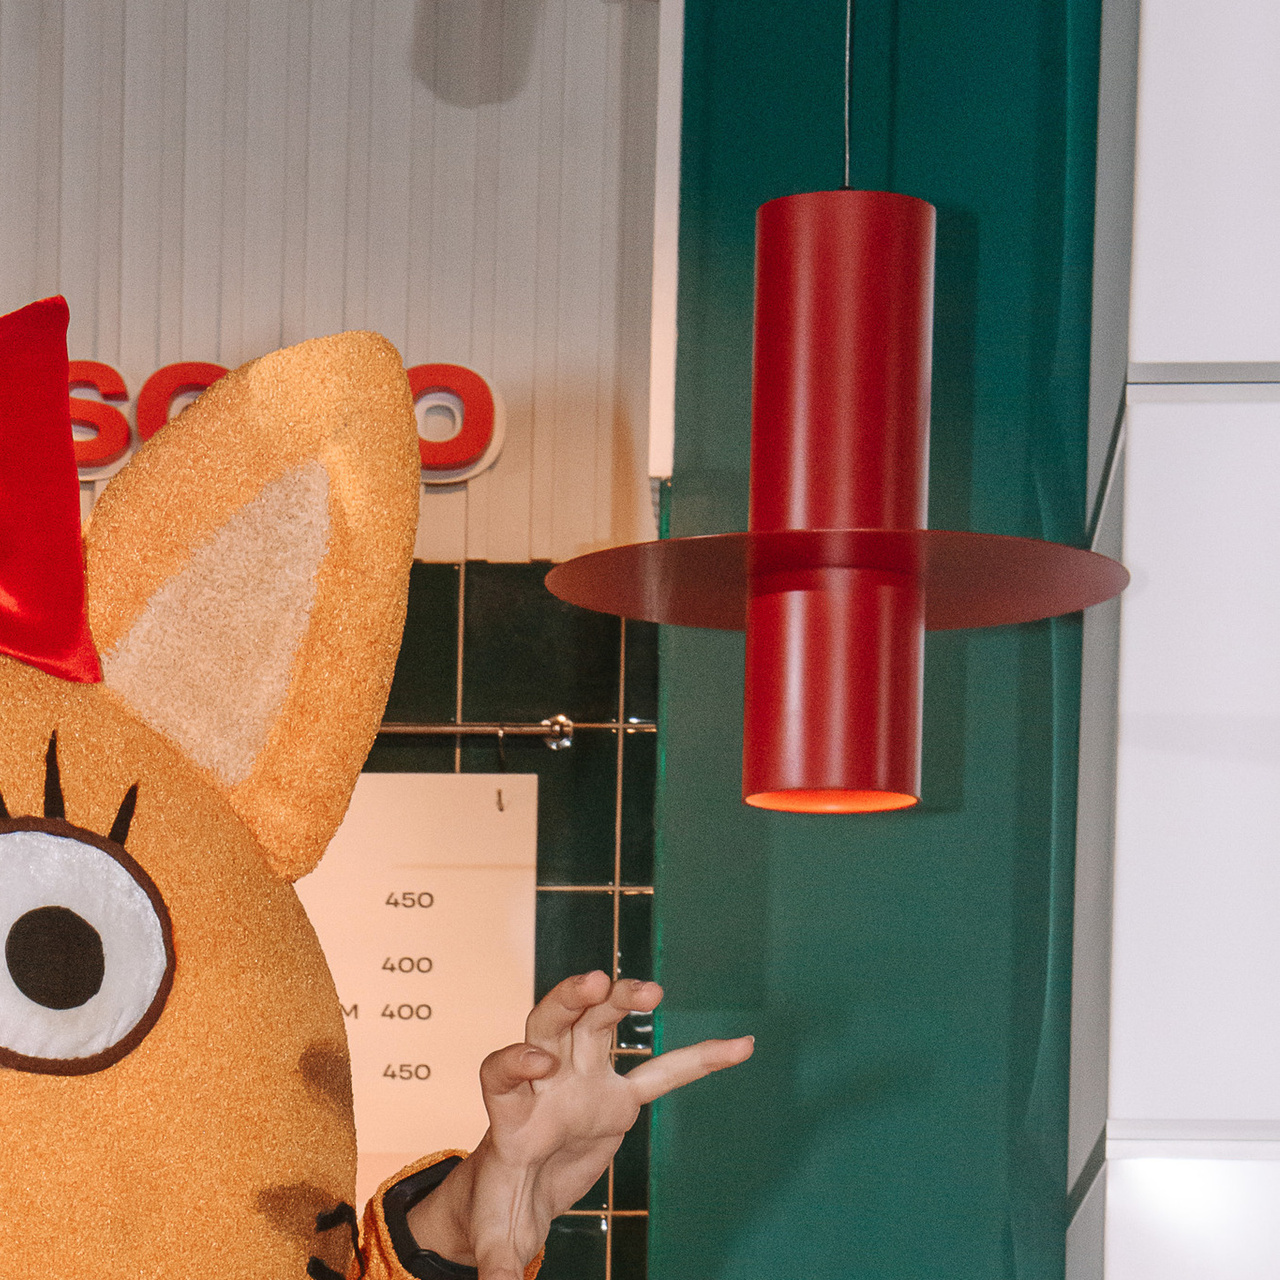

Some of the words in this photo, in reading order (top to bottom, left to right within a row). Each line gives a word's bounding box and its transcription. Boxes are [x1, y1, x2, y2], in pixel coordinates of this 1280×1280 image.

[384, 891, 435, 909] 450
[381, 957, 433, 974] 400
[381, 1003, 432, 1020] 400
[382, 1063, 432, 1081] 450
